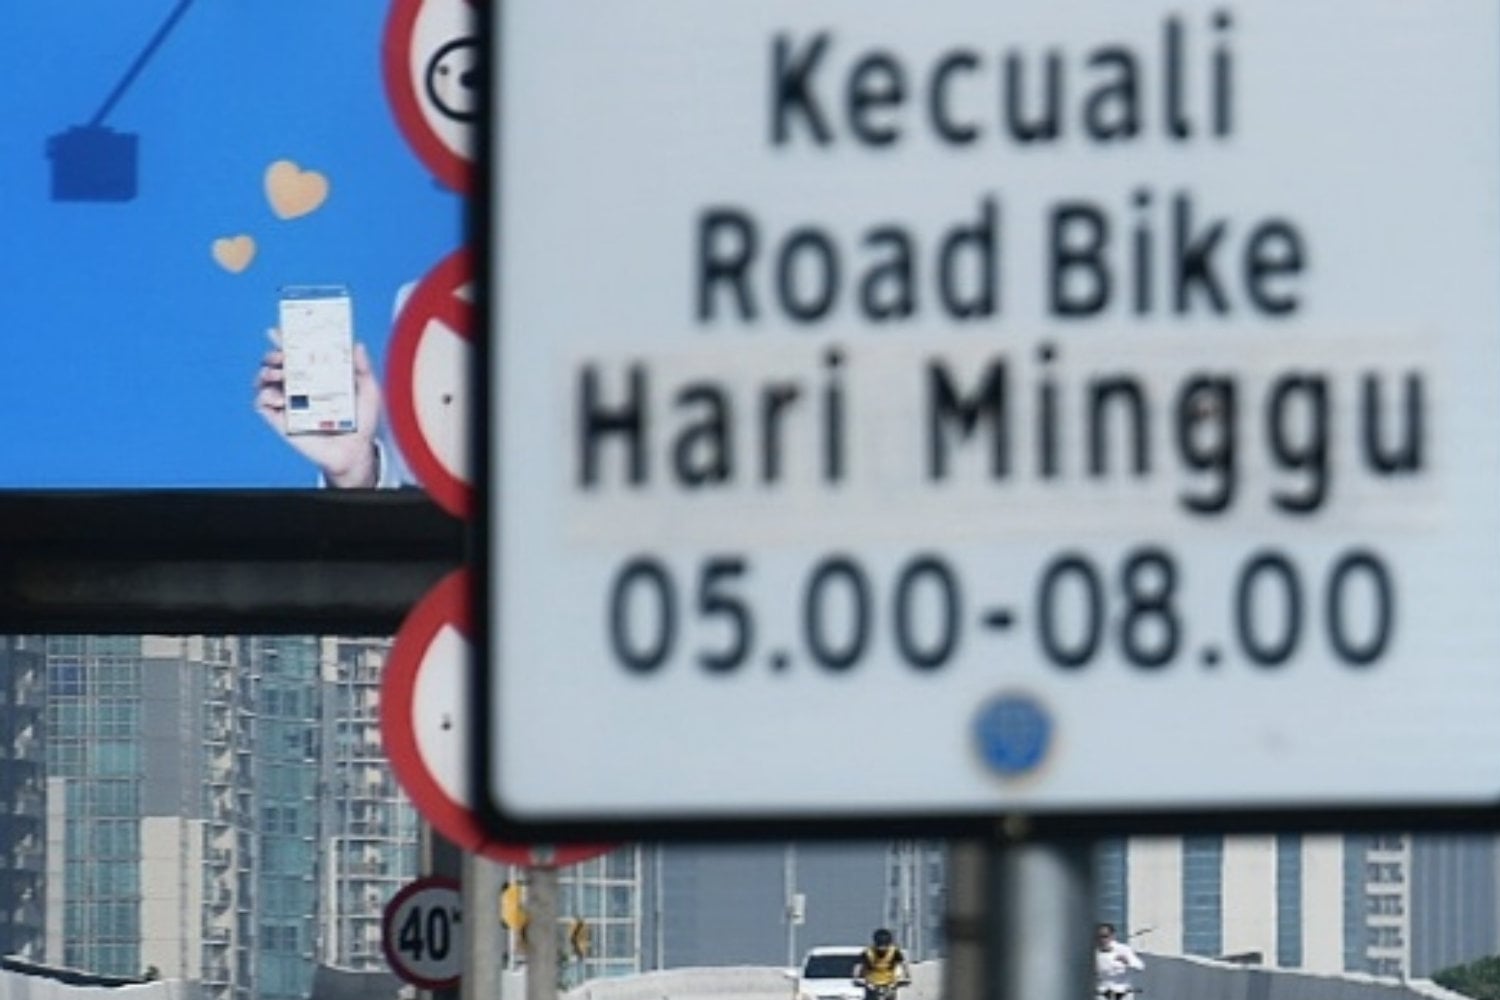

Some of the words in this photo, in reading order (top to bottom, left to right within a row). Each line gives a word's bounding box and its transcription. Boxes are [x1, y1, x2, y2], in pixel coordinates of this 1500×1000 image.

[768, 10, 1236, 150] Kecuali
[691, 194, 1002, 327] Road
[1044, 188, 1311, 322] Bike
[572, 345, 850, 492] Hari
[922, 342, 1430, 518] Minggu
[604, 543, 1400, 679] 05.00-08.00
